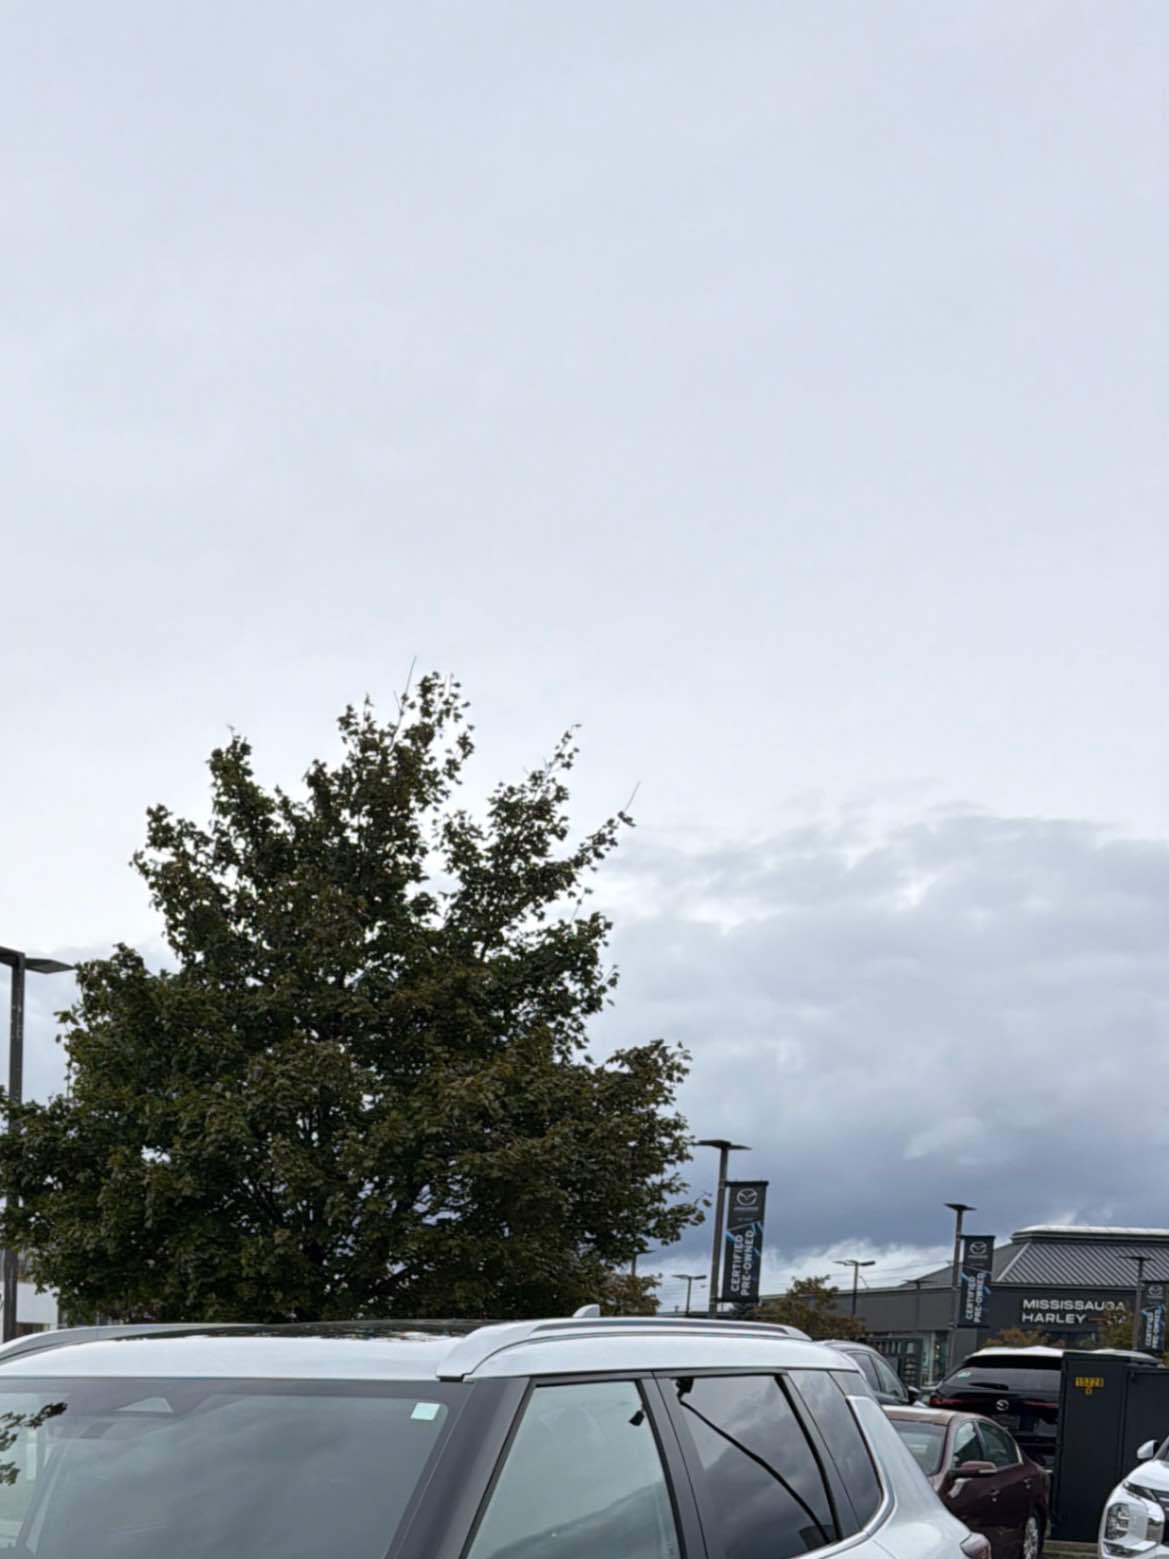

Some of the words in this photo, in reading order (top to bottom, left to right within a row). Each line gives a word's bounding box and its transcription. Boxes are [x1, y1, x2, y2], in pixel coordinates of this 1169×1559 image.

[730, 1234, 744, 1292] CERTIFIED
[740, 1230, 754, 1296] PRE-OWNED
[965, 1276, 976, 1320] CERTIFIED
[973, 1272, 986, 1323] PRE-OWNED
[1021, 1312, 1087, 1324] HARLEY
[1022, 1299, 1126, 1312] MISSISSAUGA
